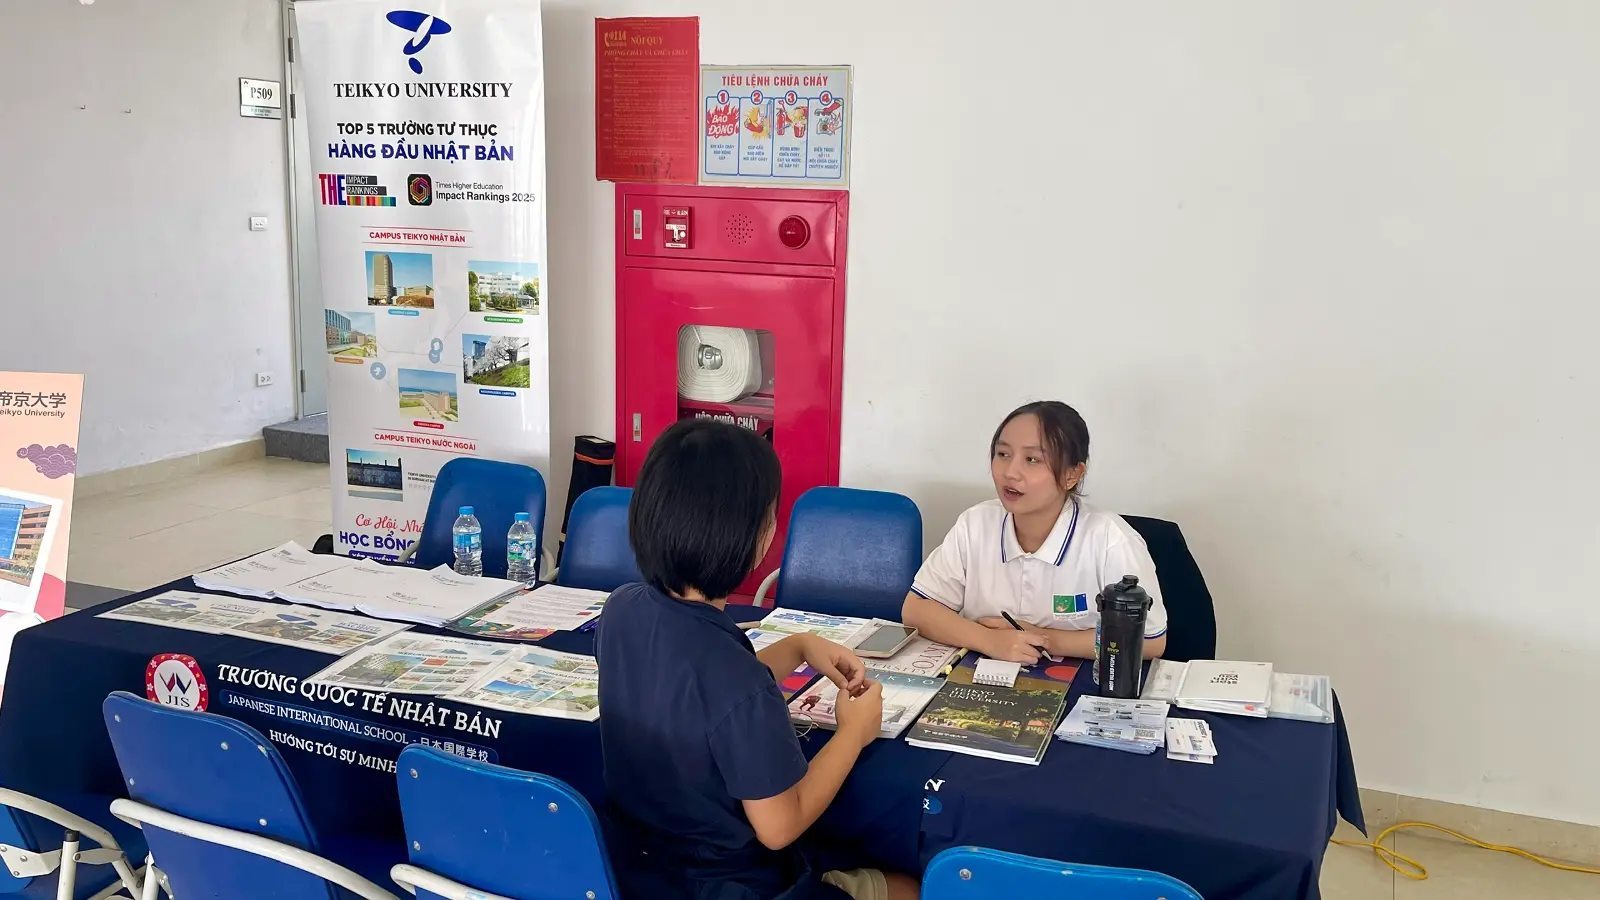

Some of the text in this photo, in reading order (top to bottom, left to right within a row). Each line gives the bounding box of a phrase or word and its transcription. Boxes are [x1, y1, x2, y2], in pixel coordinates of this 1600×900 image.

[647, 36, 663, 46] QUY
[722, 73, 828, 88] TIÊU LỆNH CHỮA CHÁY
[251, 87, 272, 100] P509
[334, 83, 513, 97] TEIKYO UNIVERSITY
[720, 93, 726, 102] 1
[753, 93, 761, 102] 2
[787, 94, 795, 102] 3
[821, 93, 830, 102] 4
[337, 120, 498, 139] TOP 5 TRƯỜNG TƯ THỤC
[708, 124, 733, 138] ĐỘNG
[328, 137, 514, 163] HÀNG ĐẦU NHẬT BẢN
[346, 175, 368, 184] IMPACT
[453, 182, 471, 190] Higher
[319, 174, 346, 205] THE
[347, 186, 378, 195] RANKINGS
[436, 191, 535, 203] Impact Rankings 2025
[430, 233, 448, 243] NHẬT
[450, 233, 465, 242] BẢN
[0, 390, 66, 408] 帝京大学
[25, 409, 65, 418] University
[737, 415, 759, 431] CHÁY
[374, 434, 475, 451] CAMPUS TEIKYO NƯỚC NGOÀI
[356, 514, 372, 526] Cơ
[374, 516, 398, 531] Hội
[340, 531, 369, 548] HỌC
[874, 673, 934, 685] IKYO
[166, 695, 190, 707] JIS
[217, 664, 297, 694] TRƯỜNG
[361, 691, 390, 713] TẾ
[388, 698, 451, 727] NHẬT
[454, 711, 502, 739] BẢN
[949, 694, 1018, 706] UNIVERSITY
[228, 694, 276, 716] JAPANESE
[277, 706, 362, 734] INTERNATIONAL
[364, 726, 409, 744] SCHOOL
[421, 737, 489, 762] 日本国際学校
[269, 730, 397, 774] HƯỚNG TỚI SỰ MINH
